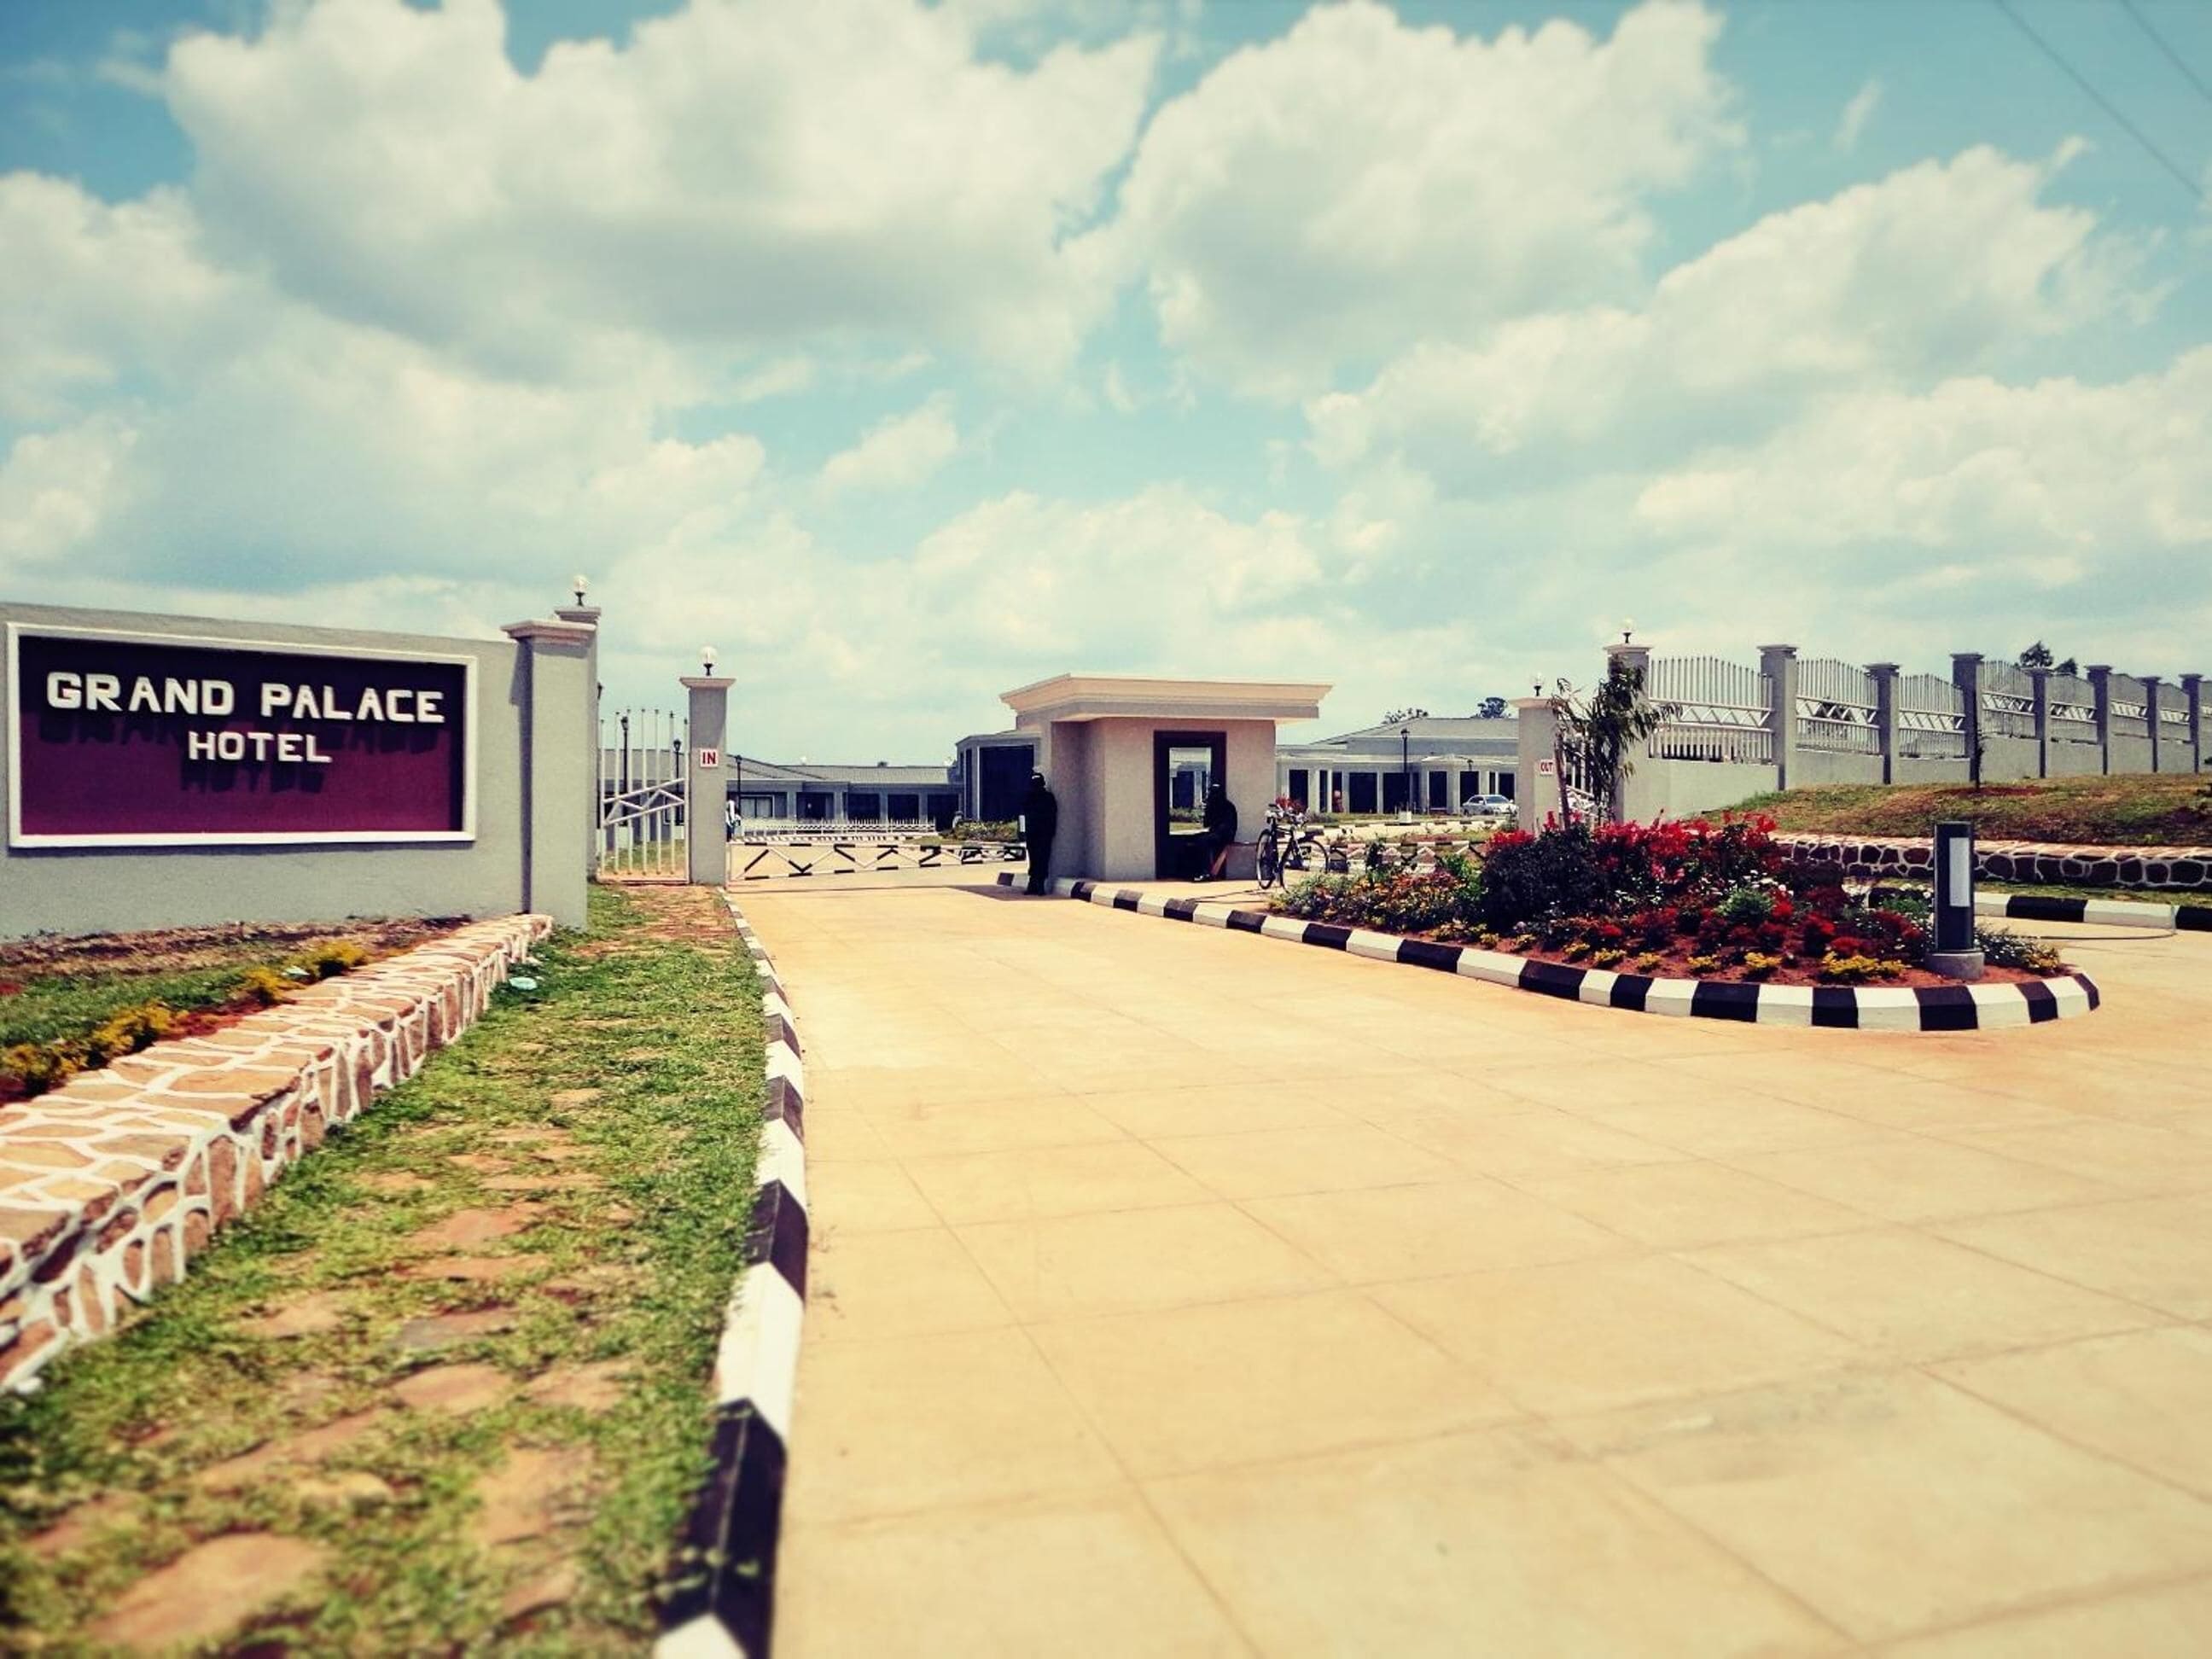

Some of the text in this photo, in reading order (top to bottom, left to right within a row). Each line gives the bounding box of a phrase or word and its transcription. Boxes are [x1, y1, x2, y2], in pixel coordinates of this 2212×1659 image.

[46, 671, 445, 723] GRAND PALACE
[187, 731, 333, 763] HOTEL
[702, 751, 716, 765] IN
